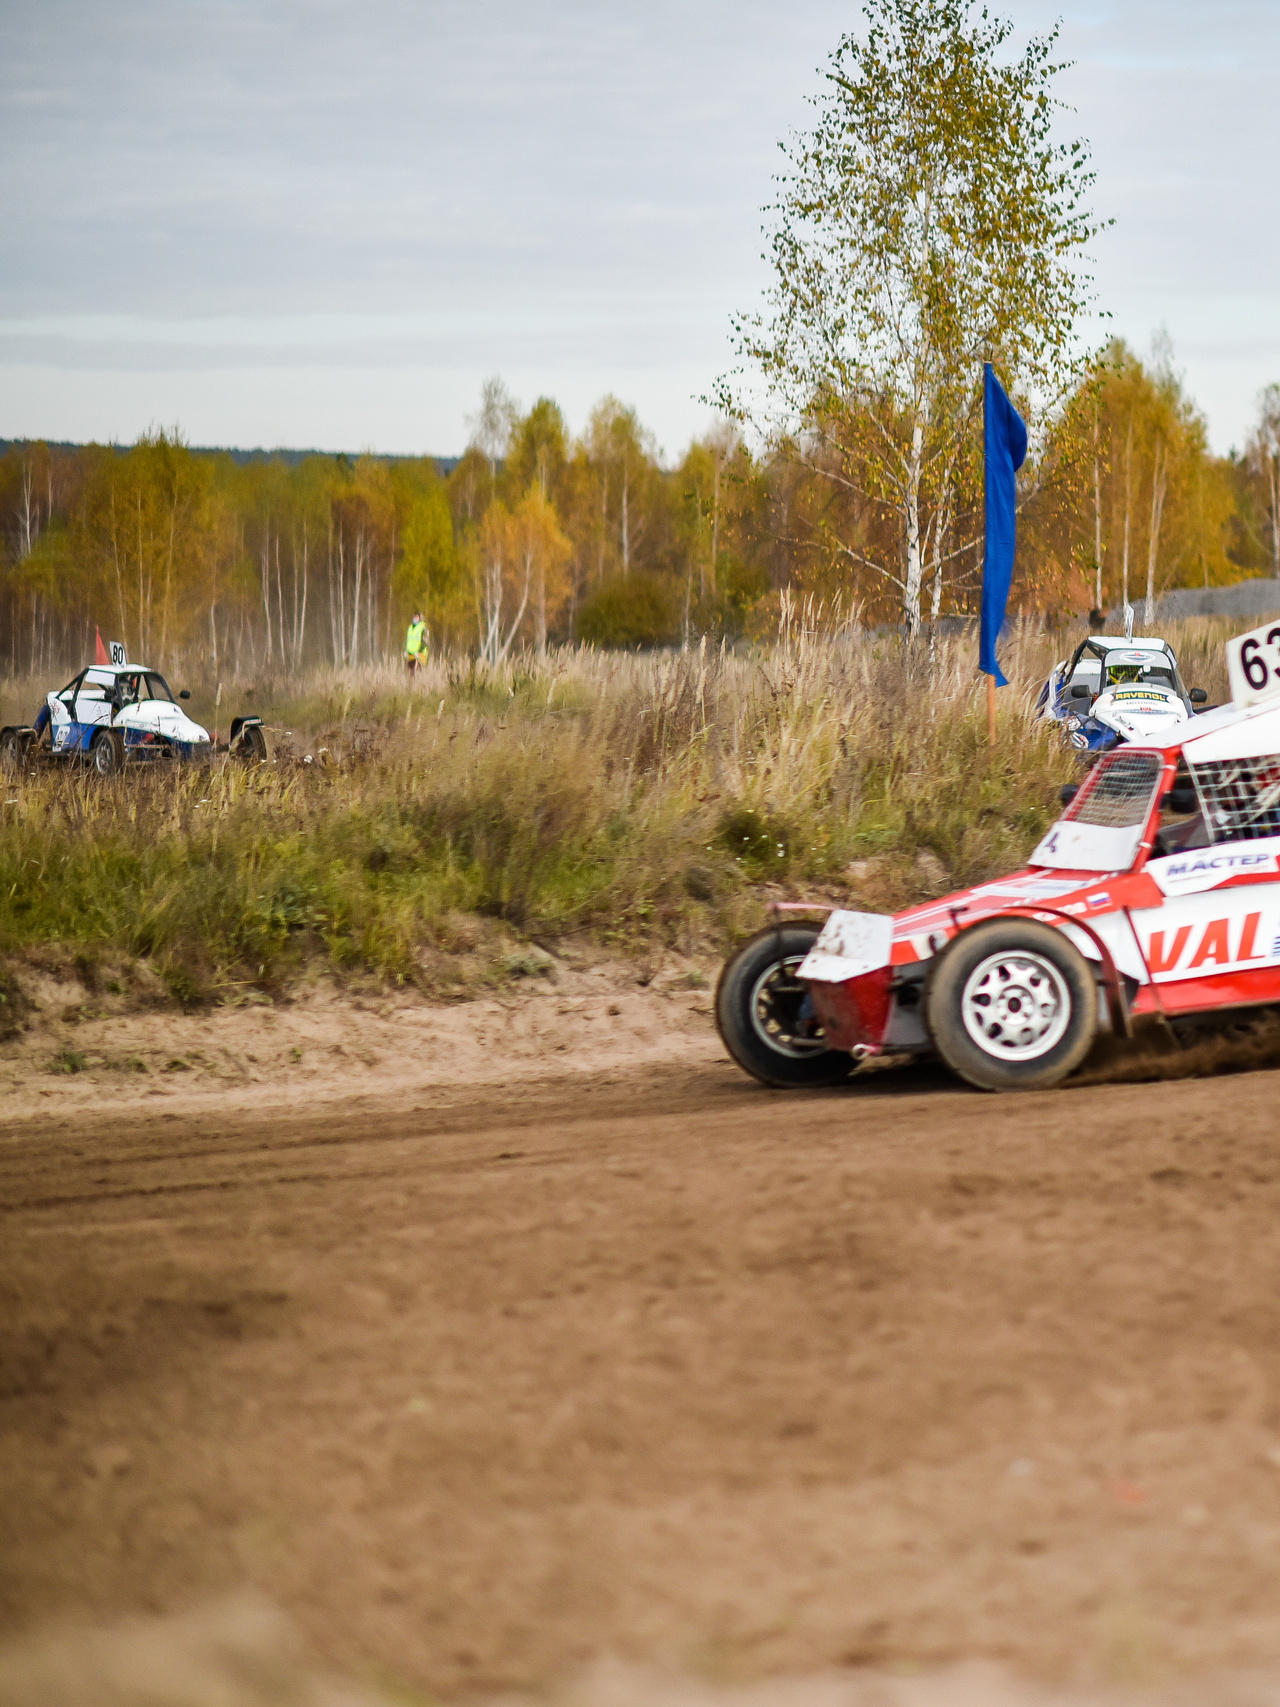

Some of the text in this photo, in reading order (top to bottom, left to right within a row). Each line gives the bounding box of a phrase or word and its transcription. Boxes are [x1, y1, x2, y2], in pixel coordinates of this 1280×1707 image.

[112, 644, 124, 665] 80
[1115, 691, 1167, 702] RAVENOL
[1165, 853, 1270, 877] МАСТЕР
[1149, 911, 1267, 974] VAL
